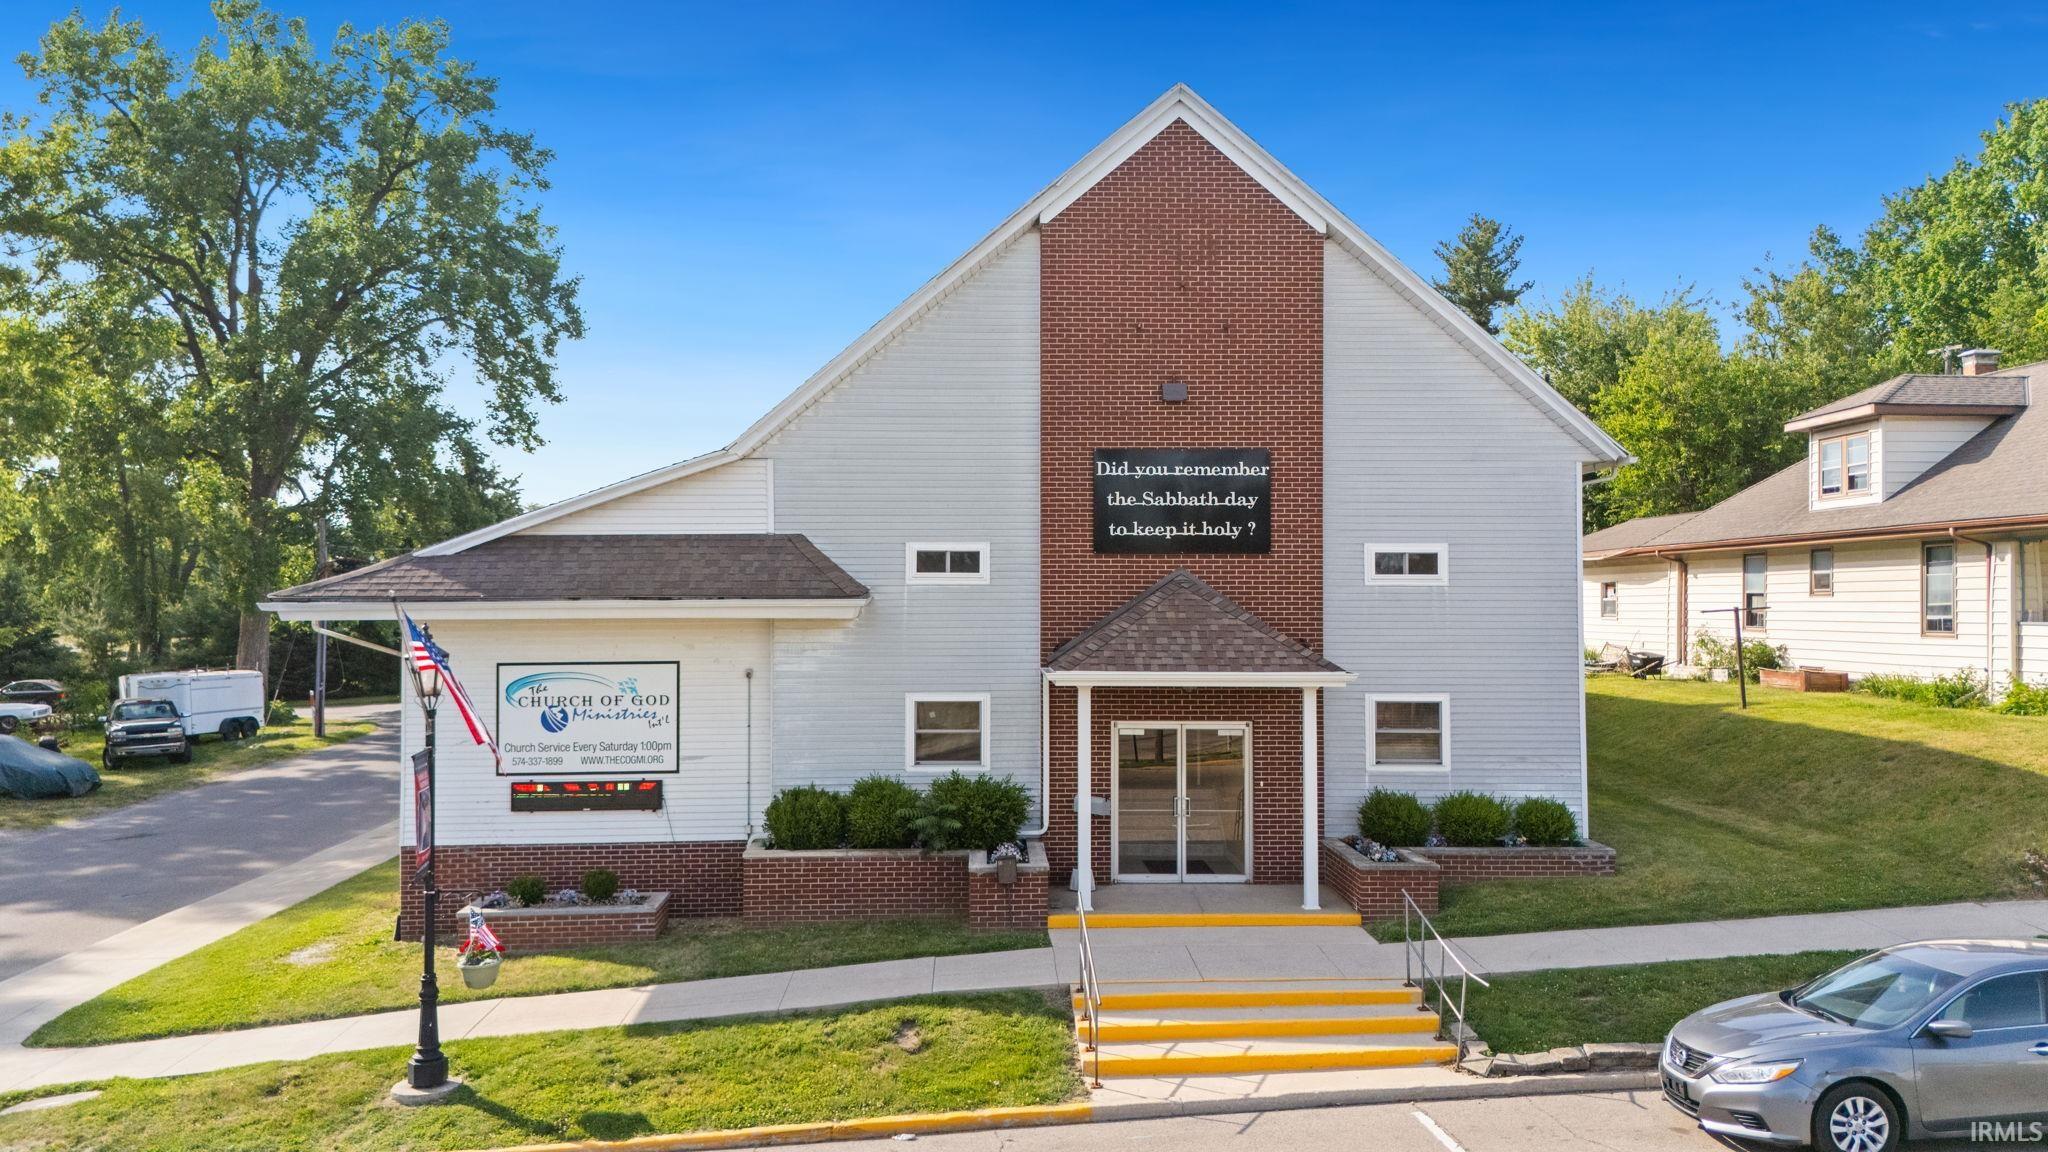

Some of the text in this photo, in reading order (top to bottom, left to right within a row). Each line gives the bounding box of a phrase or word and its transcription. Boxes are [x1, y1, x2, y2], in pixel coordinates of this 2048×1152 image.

[1096, 461, 1270, 479] Did you remember
[1107, 490, 1259, 509] the Sabbath day
[1109, 522, 1127, 536] to
[1133, 521, 1177, 539] keep
[1183, 522, 1196, 536] it
[1202, 521, 1243, 539] holy
[529, 683, 548, 695] The
[518, 694, 670, 708] CHURCH OF GOD
[572, 707, 657, 722] Ministries
[504, 741, 672, 753] Church Service Every Saturday 1:00pm
[512, 755, 664, 766] 574-337-1899 WWW.THECOGMI.ORG
